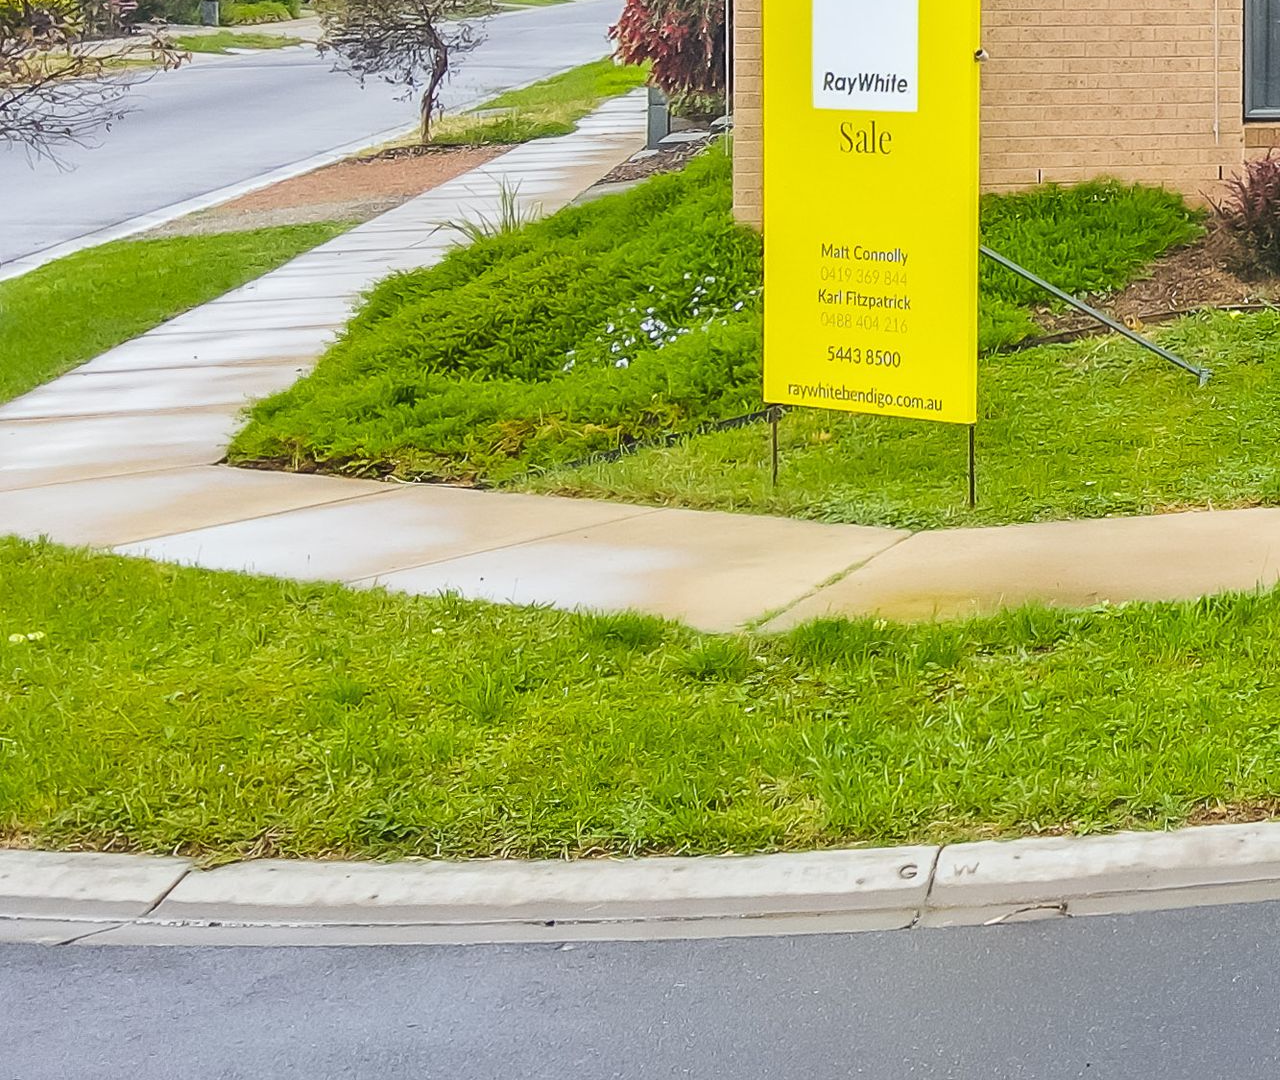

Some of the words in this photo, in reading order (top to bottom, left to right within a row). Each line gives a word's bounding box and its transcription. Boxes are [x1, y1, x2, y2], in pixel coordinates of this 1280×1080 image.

[839, 120, 892, 155] Sale
[821, 243, 850, 260] Matt
[853, 245, 908, 266] Connolly
[820, 267, 852, 283] 0419
[818, 289, 842, 305] Karl
[846, 291, 911, 311] Fitzpatrick
[827, 346, 862, 364] 5443
[866, 349, 901, 368] 8500
[788, 381, 943, 411] raywhitebendigo.com.au
